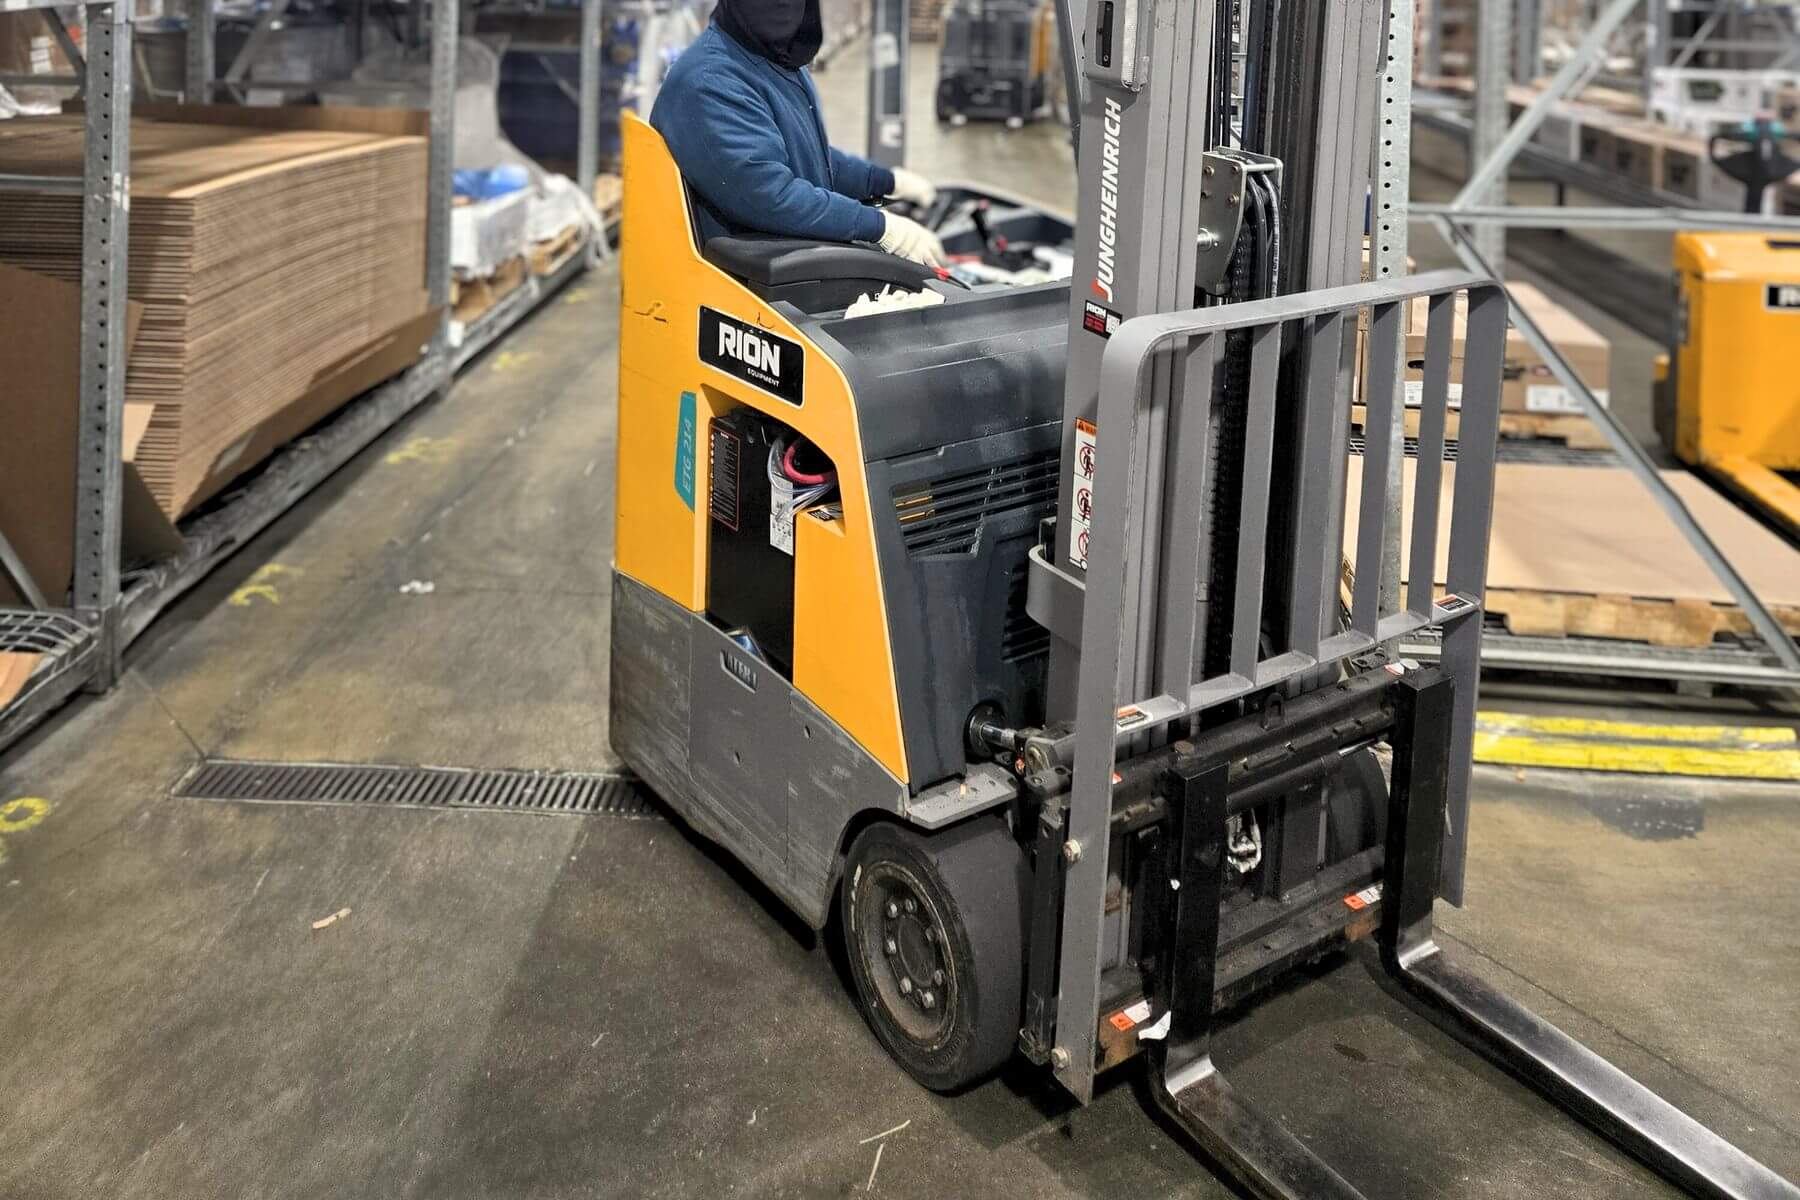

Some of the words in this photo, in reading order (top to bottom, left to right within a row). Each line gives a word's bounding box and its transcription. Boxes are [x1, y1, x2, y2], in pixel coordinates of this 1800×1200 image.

[1091, 97, 1122, 304] JUNGHEINRICH
[719, 321, 780, 377] RION
[747, 367, 780, 387] EQUIPMENT
